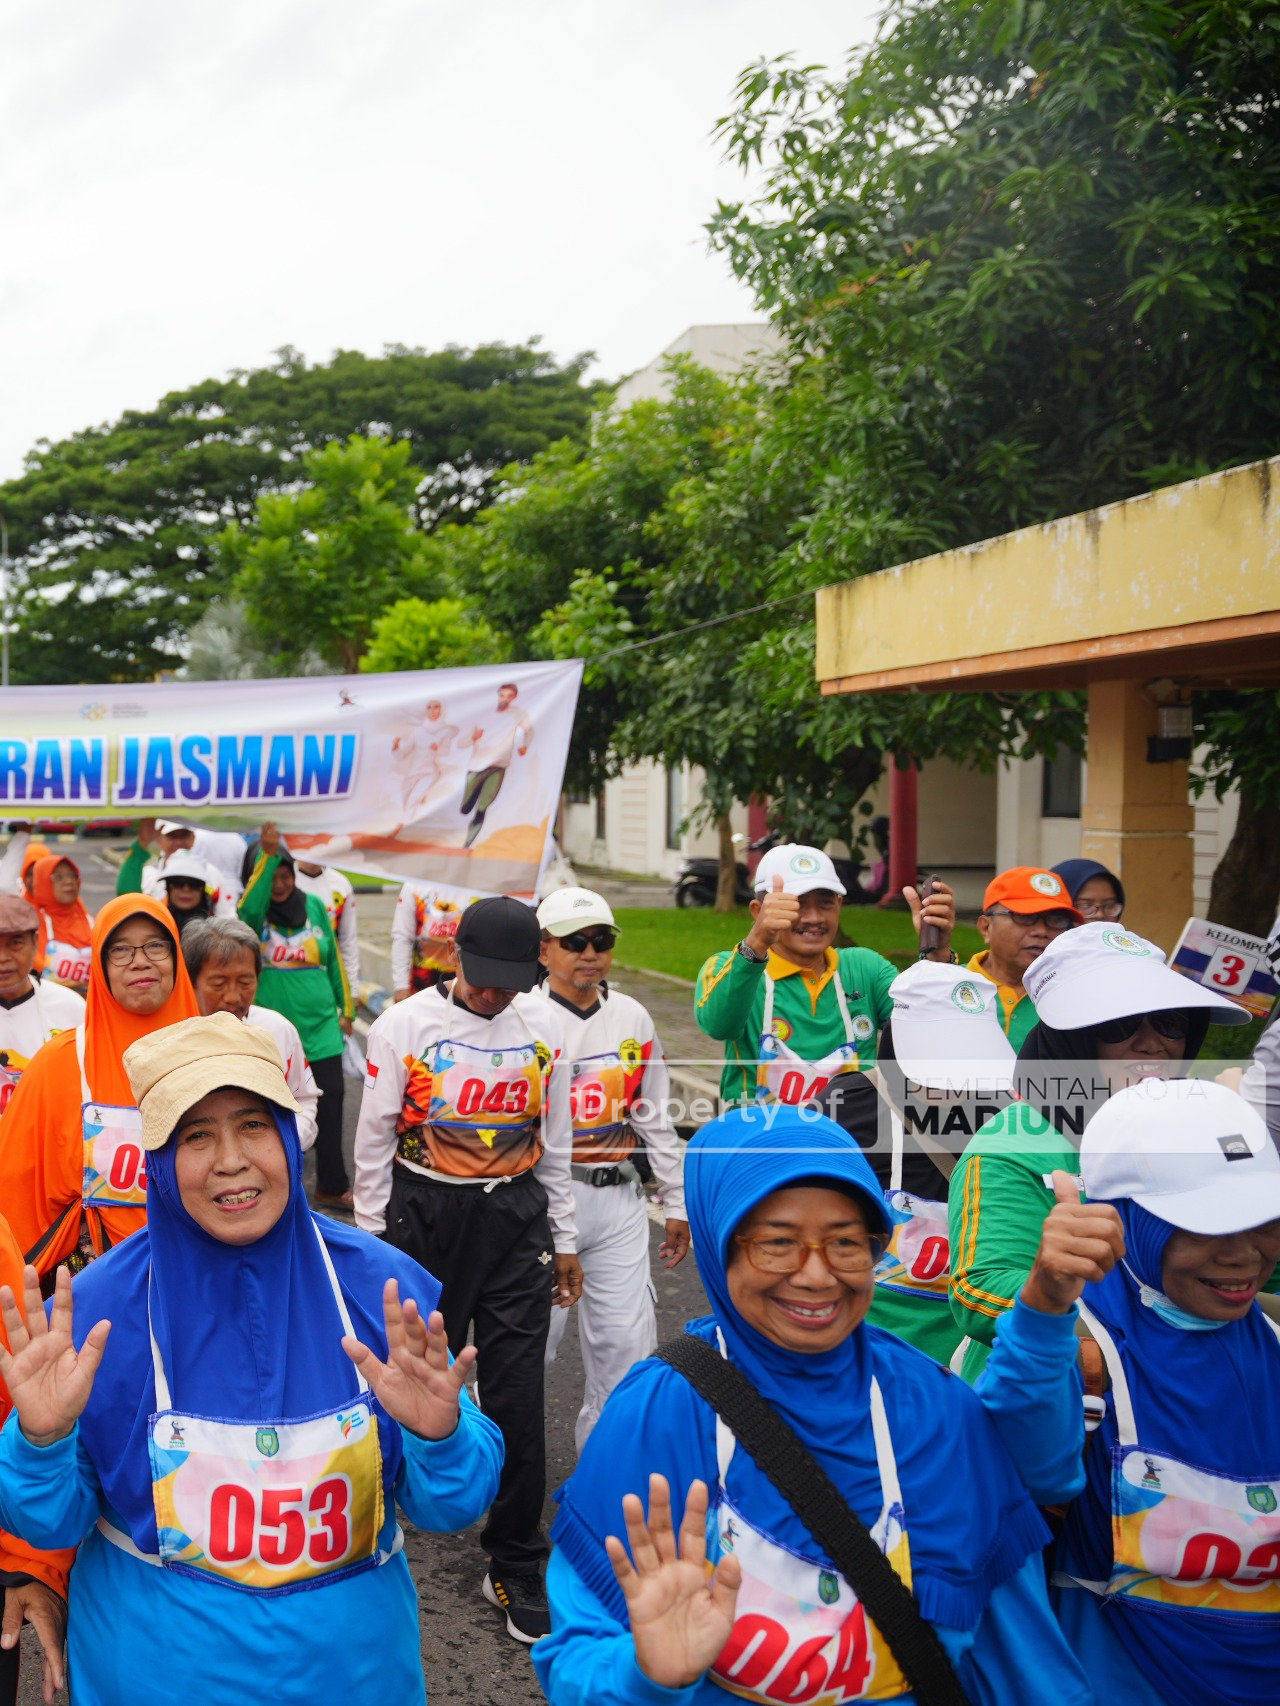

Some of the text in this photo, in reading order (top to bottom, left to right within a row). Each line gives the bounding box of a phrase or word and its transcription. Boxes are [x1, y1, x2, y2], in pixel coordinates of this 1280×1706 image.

[118, 734, 356, 800] JASMANI
[1212, 955, 1245, 986] 3
[457, 1078, 528, 1115] 043
[209, 1478, 358, 1565] 053
[710, 1602, 871, 1704] 064
